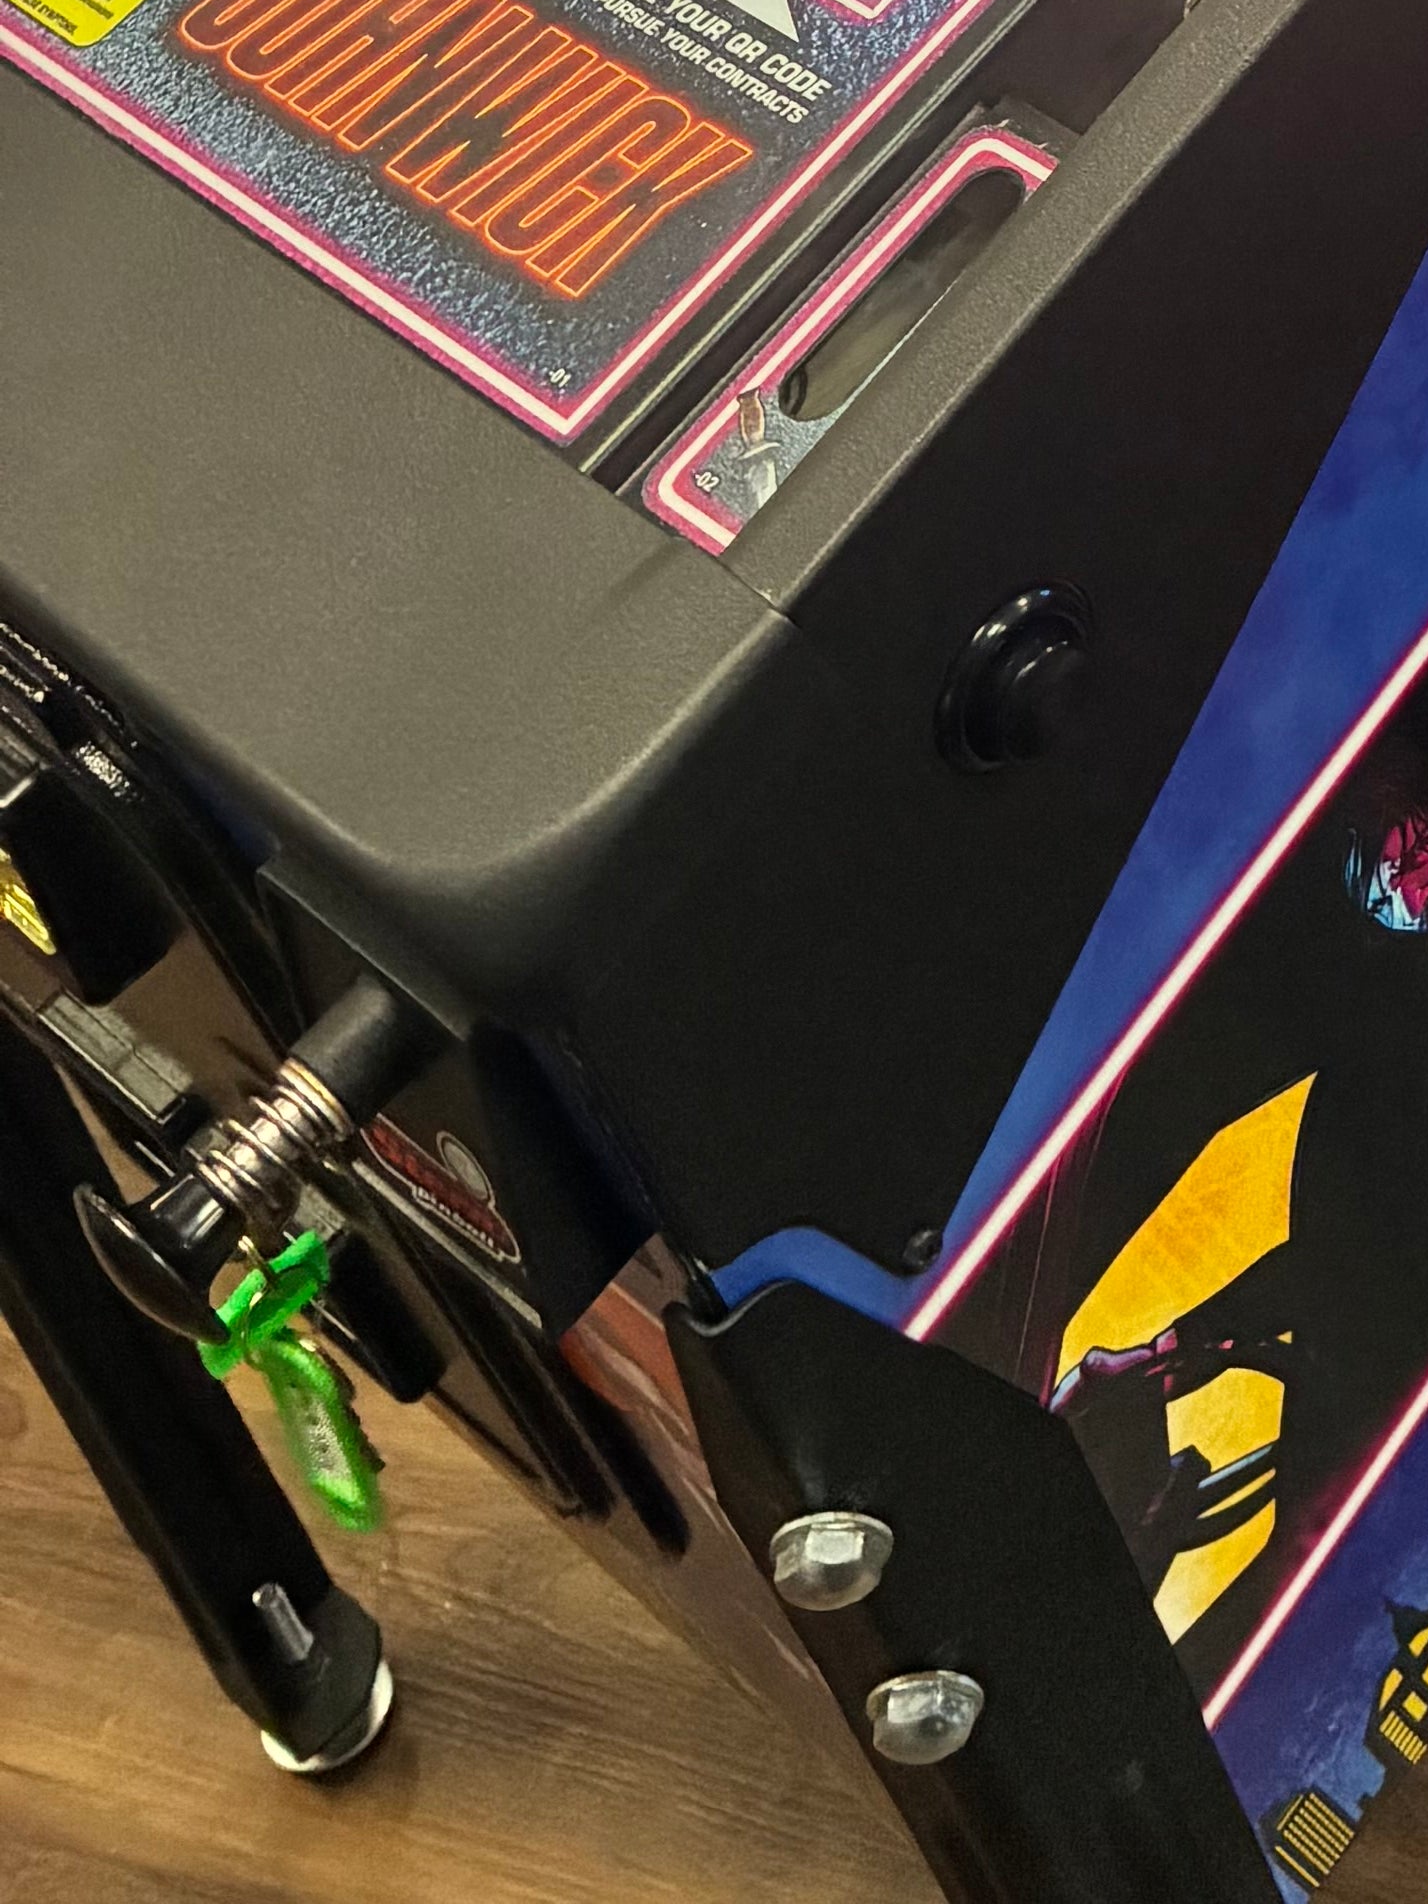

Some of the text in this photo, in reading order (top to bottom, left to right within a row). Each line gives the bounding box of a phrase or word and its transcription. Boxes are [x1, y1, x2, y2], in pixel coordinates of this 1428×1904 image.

[660, 27, 711, 65] YOUR
[704, 57, 809, 124] CONTRACTS
[725, 31, 768, 64] QR
[760, 53, 832, 101] CODE
[385, 27, 752, 296] WICK
